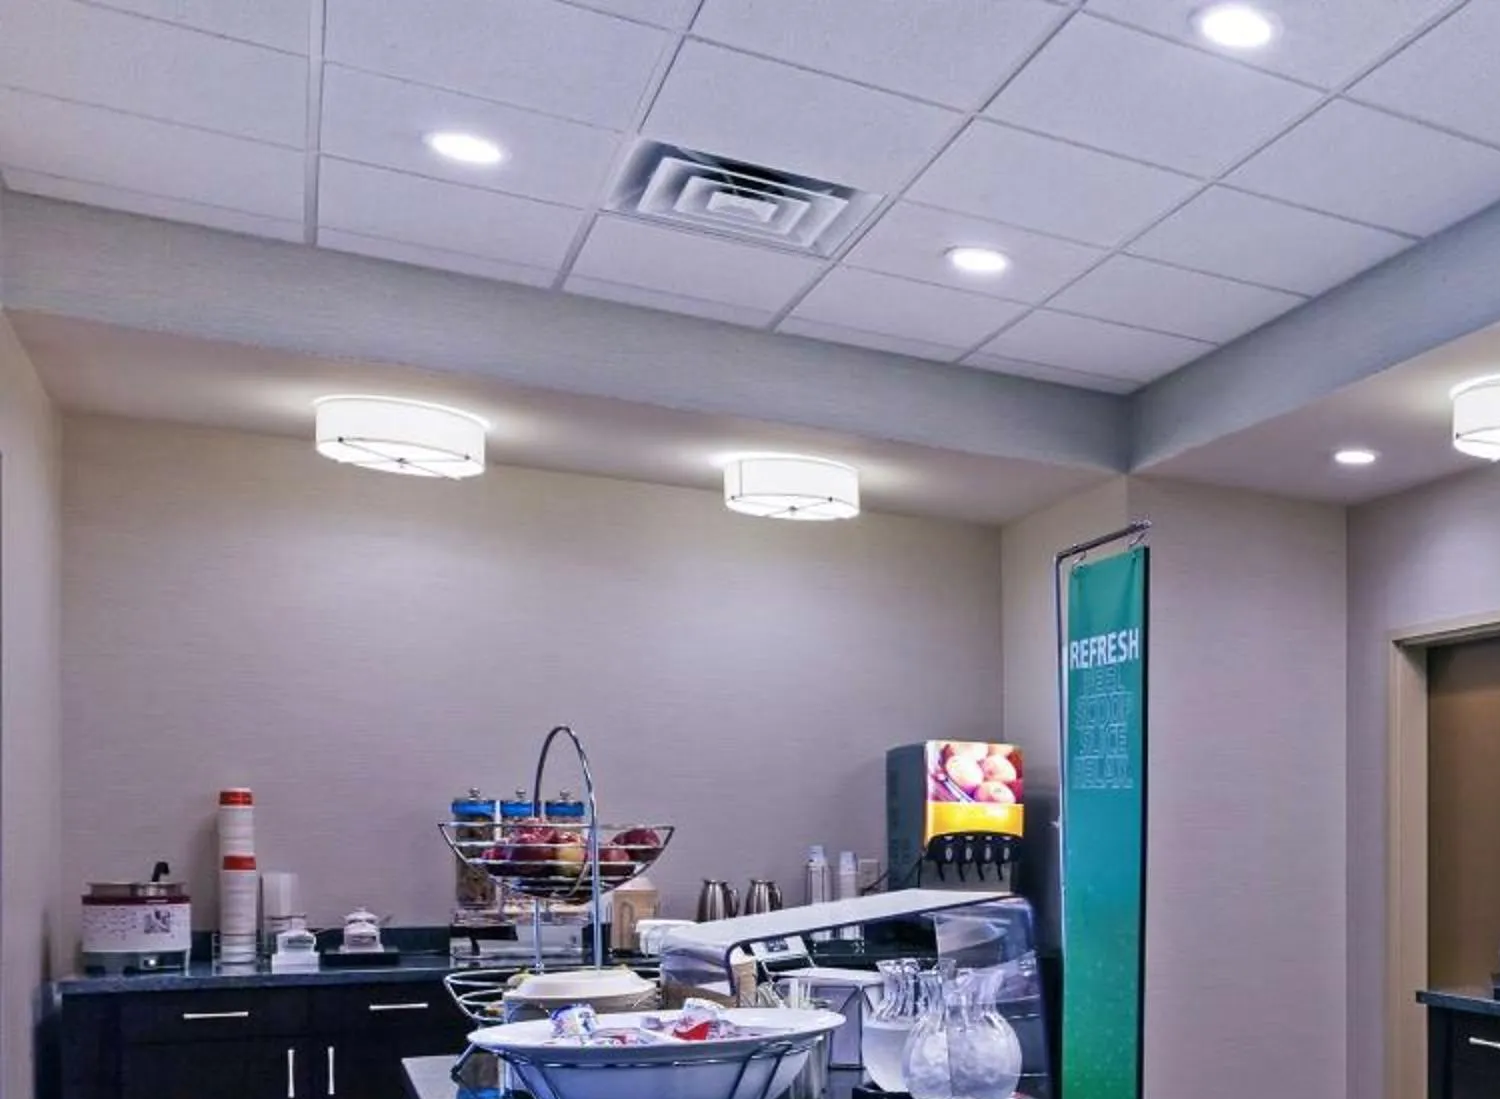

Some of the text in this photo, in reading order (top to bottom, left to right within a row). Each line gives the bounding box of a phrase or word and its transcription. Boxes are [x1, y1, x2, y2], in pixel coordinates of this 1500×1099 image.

[1069, 628, 1140, 670] REFRESH
[1075, 691, 1135, 729] SCOOP
[1079, 722, 1129, 756] SLICE
